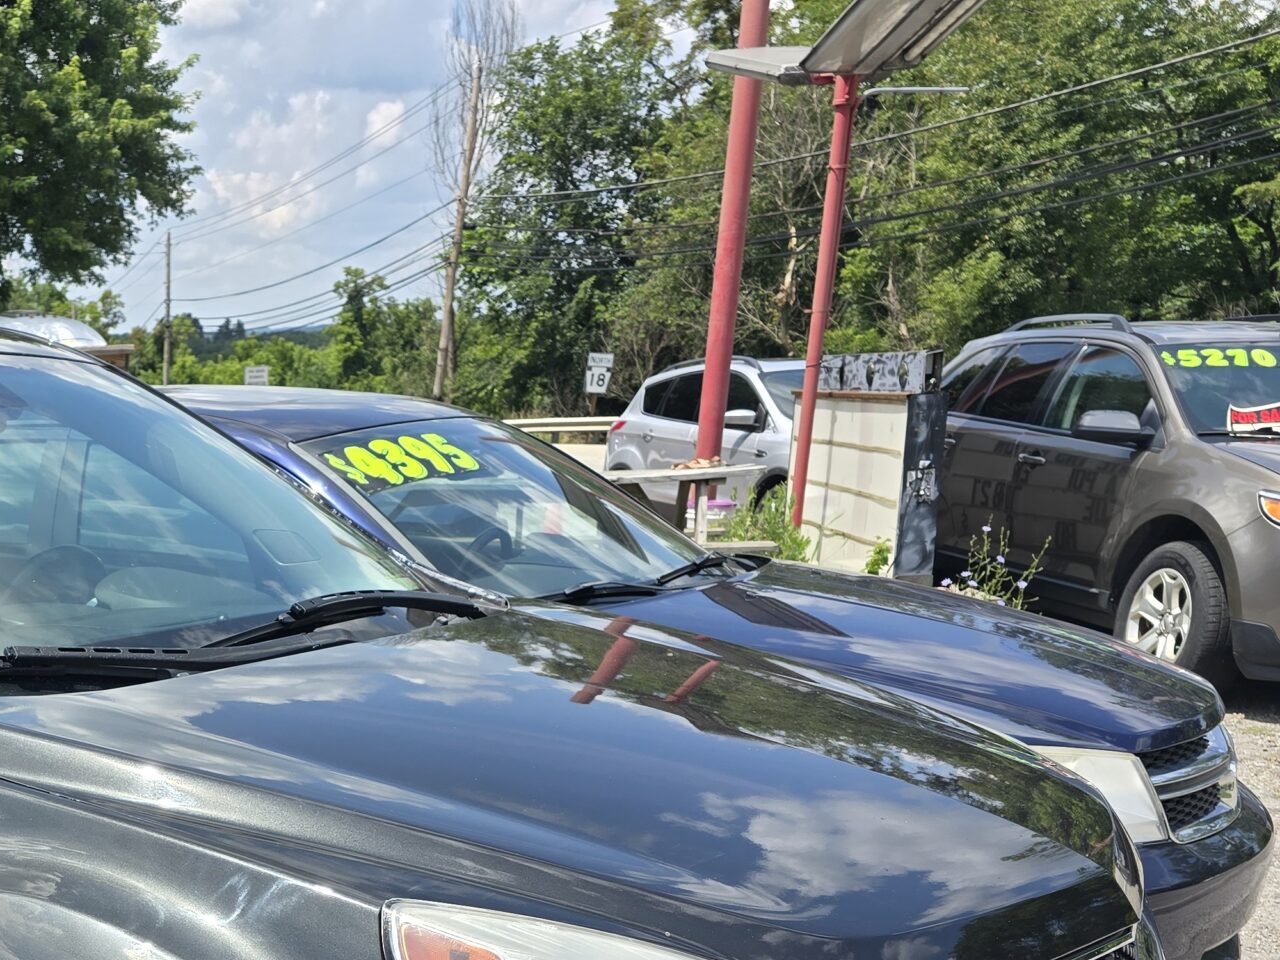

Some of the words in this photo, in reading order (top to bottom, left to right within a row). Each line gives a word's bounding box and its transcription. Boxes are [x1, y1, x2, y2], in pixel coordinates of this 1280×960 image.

[1160, 348, 1277, 368] $5270
[590, 373, 606, 387] 18
[1231, 410, 1258, 423] FOR
[323, 433, 480, 485] $4395
